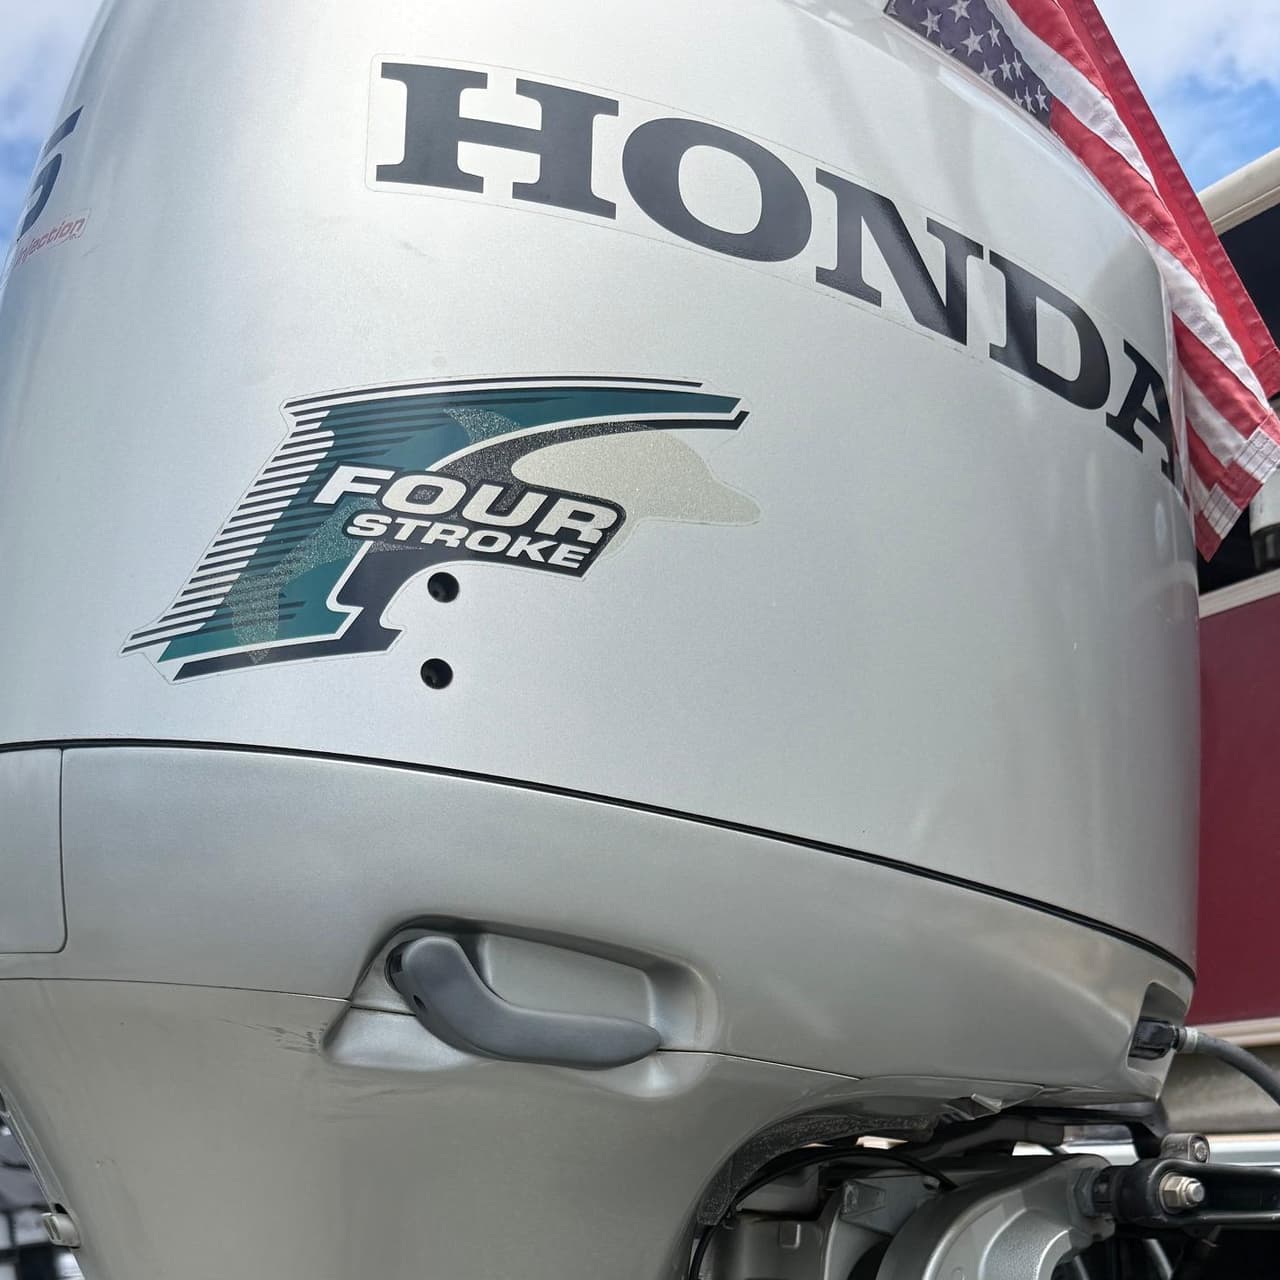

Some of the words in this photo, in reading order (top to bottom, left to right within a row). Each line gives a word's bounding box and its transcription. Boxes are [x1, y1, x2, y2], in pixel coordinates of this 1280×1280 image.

[376, 62, 1176, 485] HONDA
[313, 465, 619, 545] FOUR
[346, 513, 593, 569] STROKE
